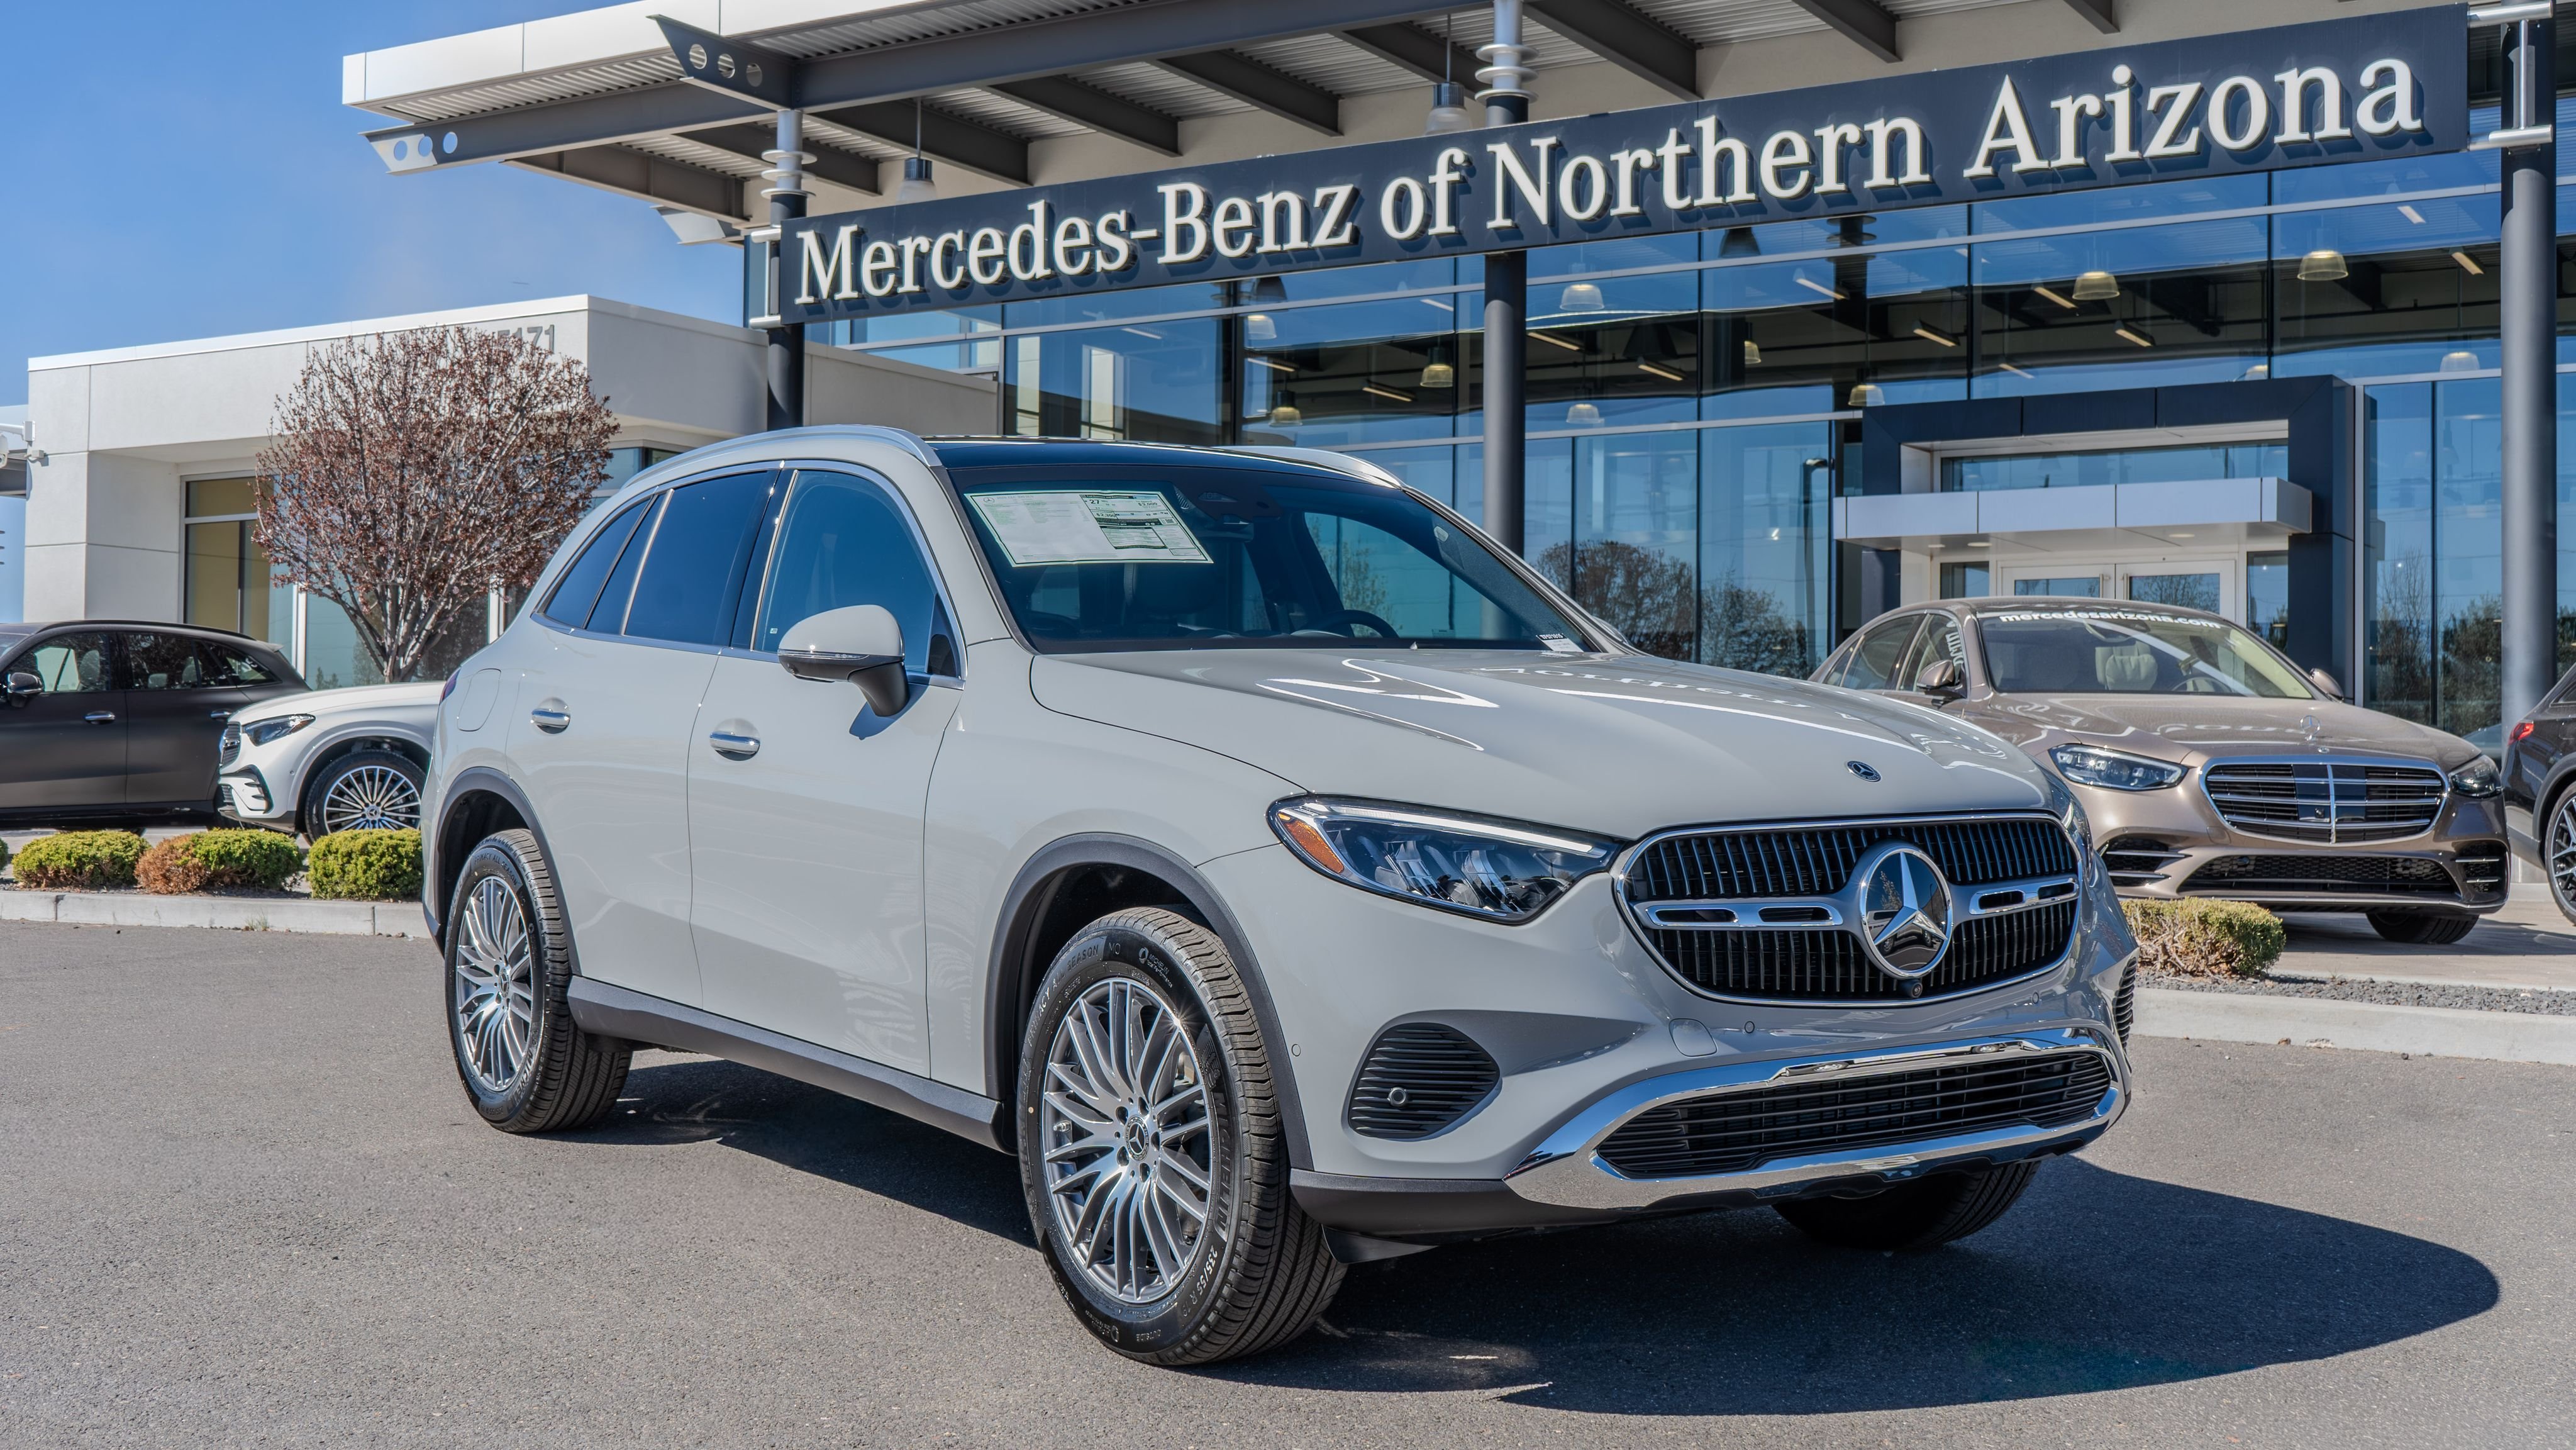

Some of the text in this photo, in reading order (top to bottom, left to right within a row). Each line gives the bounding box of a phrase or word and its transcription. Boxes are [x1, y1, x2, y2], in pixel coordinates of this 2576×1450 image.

[795, 59, 2422, 304] Mercedes-Benz of Northern Arizona
[1999, 610, 2221, 628] mercedesarizona.com
[1067, 945, 1099, 968] SEASON
[1149, 953, 1170, 974] MICHELIN
[1196, 1244, 1219, 1296] 235/55
[1136, 1329, 1161, 1342] OUTSIDE
